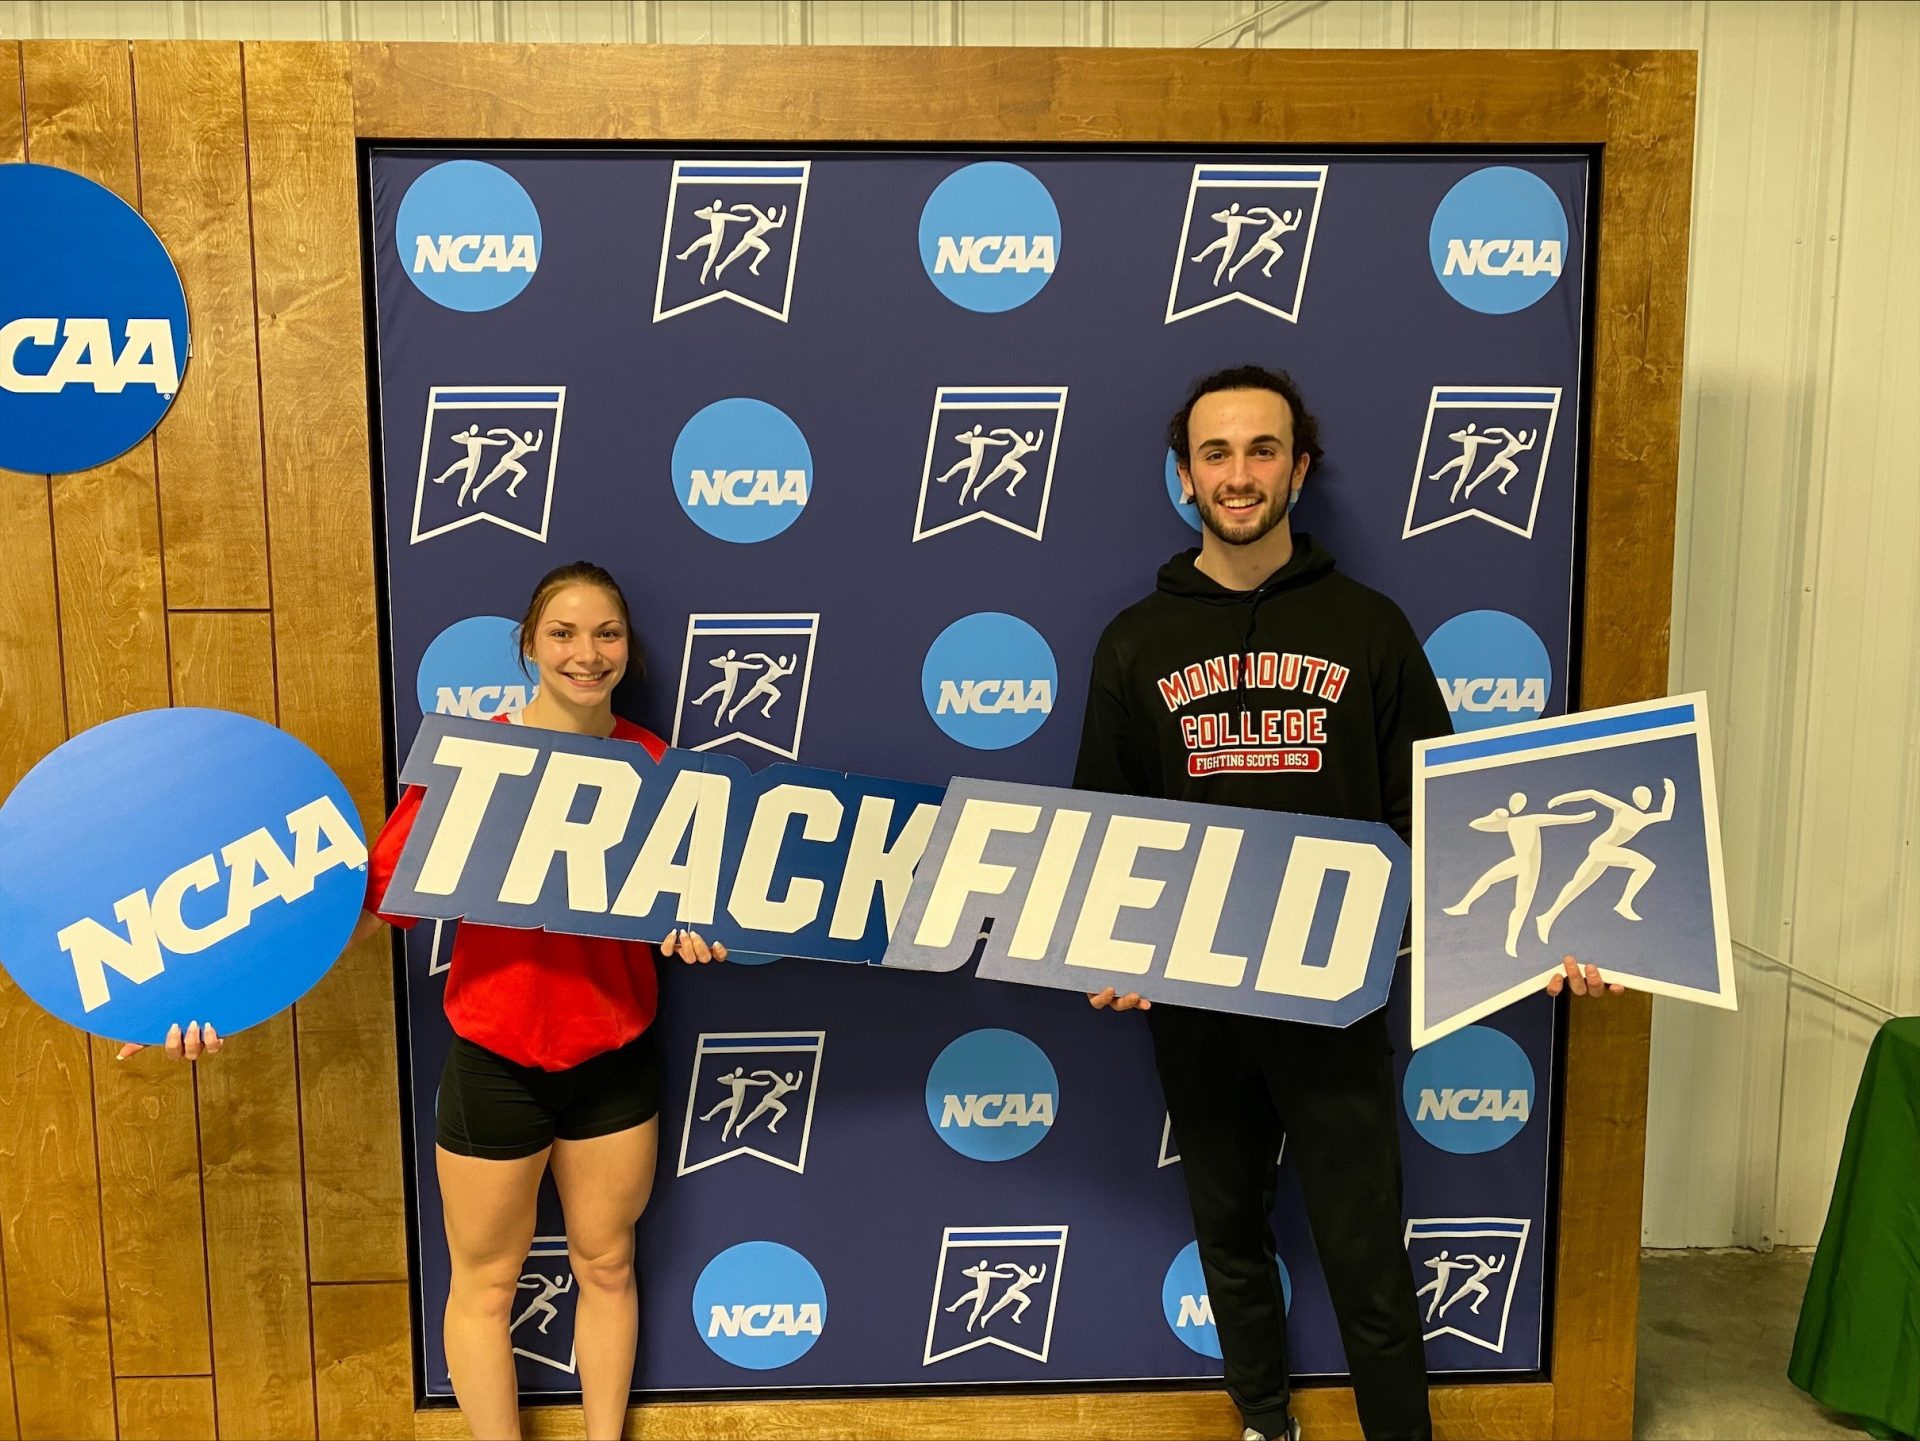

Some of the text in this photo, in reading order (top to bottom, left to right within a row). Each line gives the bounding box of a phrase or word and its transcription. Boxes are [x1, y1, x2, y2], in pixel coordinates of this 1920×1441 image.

[414, 235, 538, 273] NCAA
[934, 236, 1056, 273] NCAA
[1443, 239, 1561, 277] NCAA
[0, 318, 178, 394] CAA
[688, 470, 808, 505] NCAA
[937, 680, 1053, 714] NCAA
[1157, 652, 1349, 712] MONMOUTH
[435, 685, 540, 719] NCA
[1181, 708, 1327, 749] COLLEGE
[1196, 753, 1309, 770] FIGHTING SCOTS 1853
[414, 735, 1393, 1001] TRACK FIELD
[57, 795, 367, 1013] NCAA
[939, 1093, 1054, 1127] NCAA
[1416, 1088, 1530, 1122] NCAA
[708, 1303, 822, 1337] NCAA
